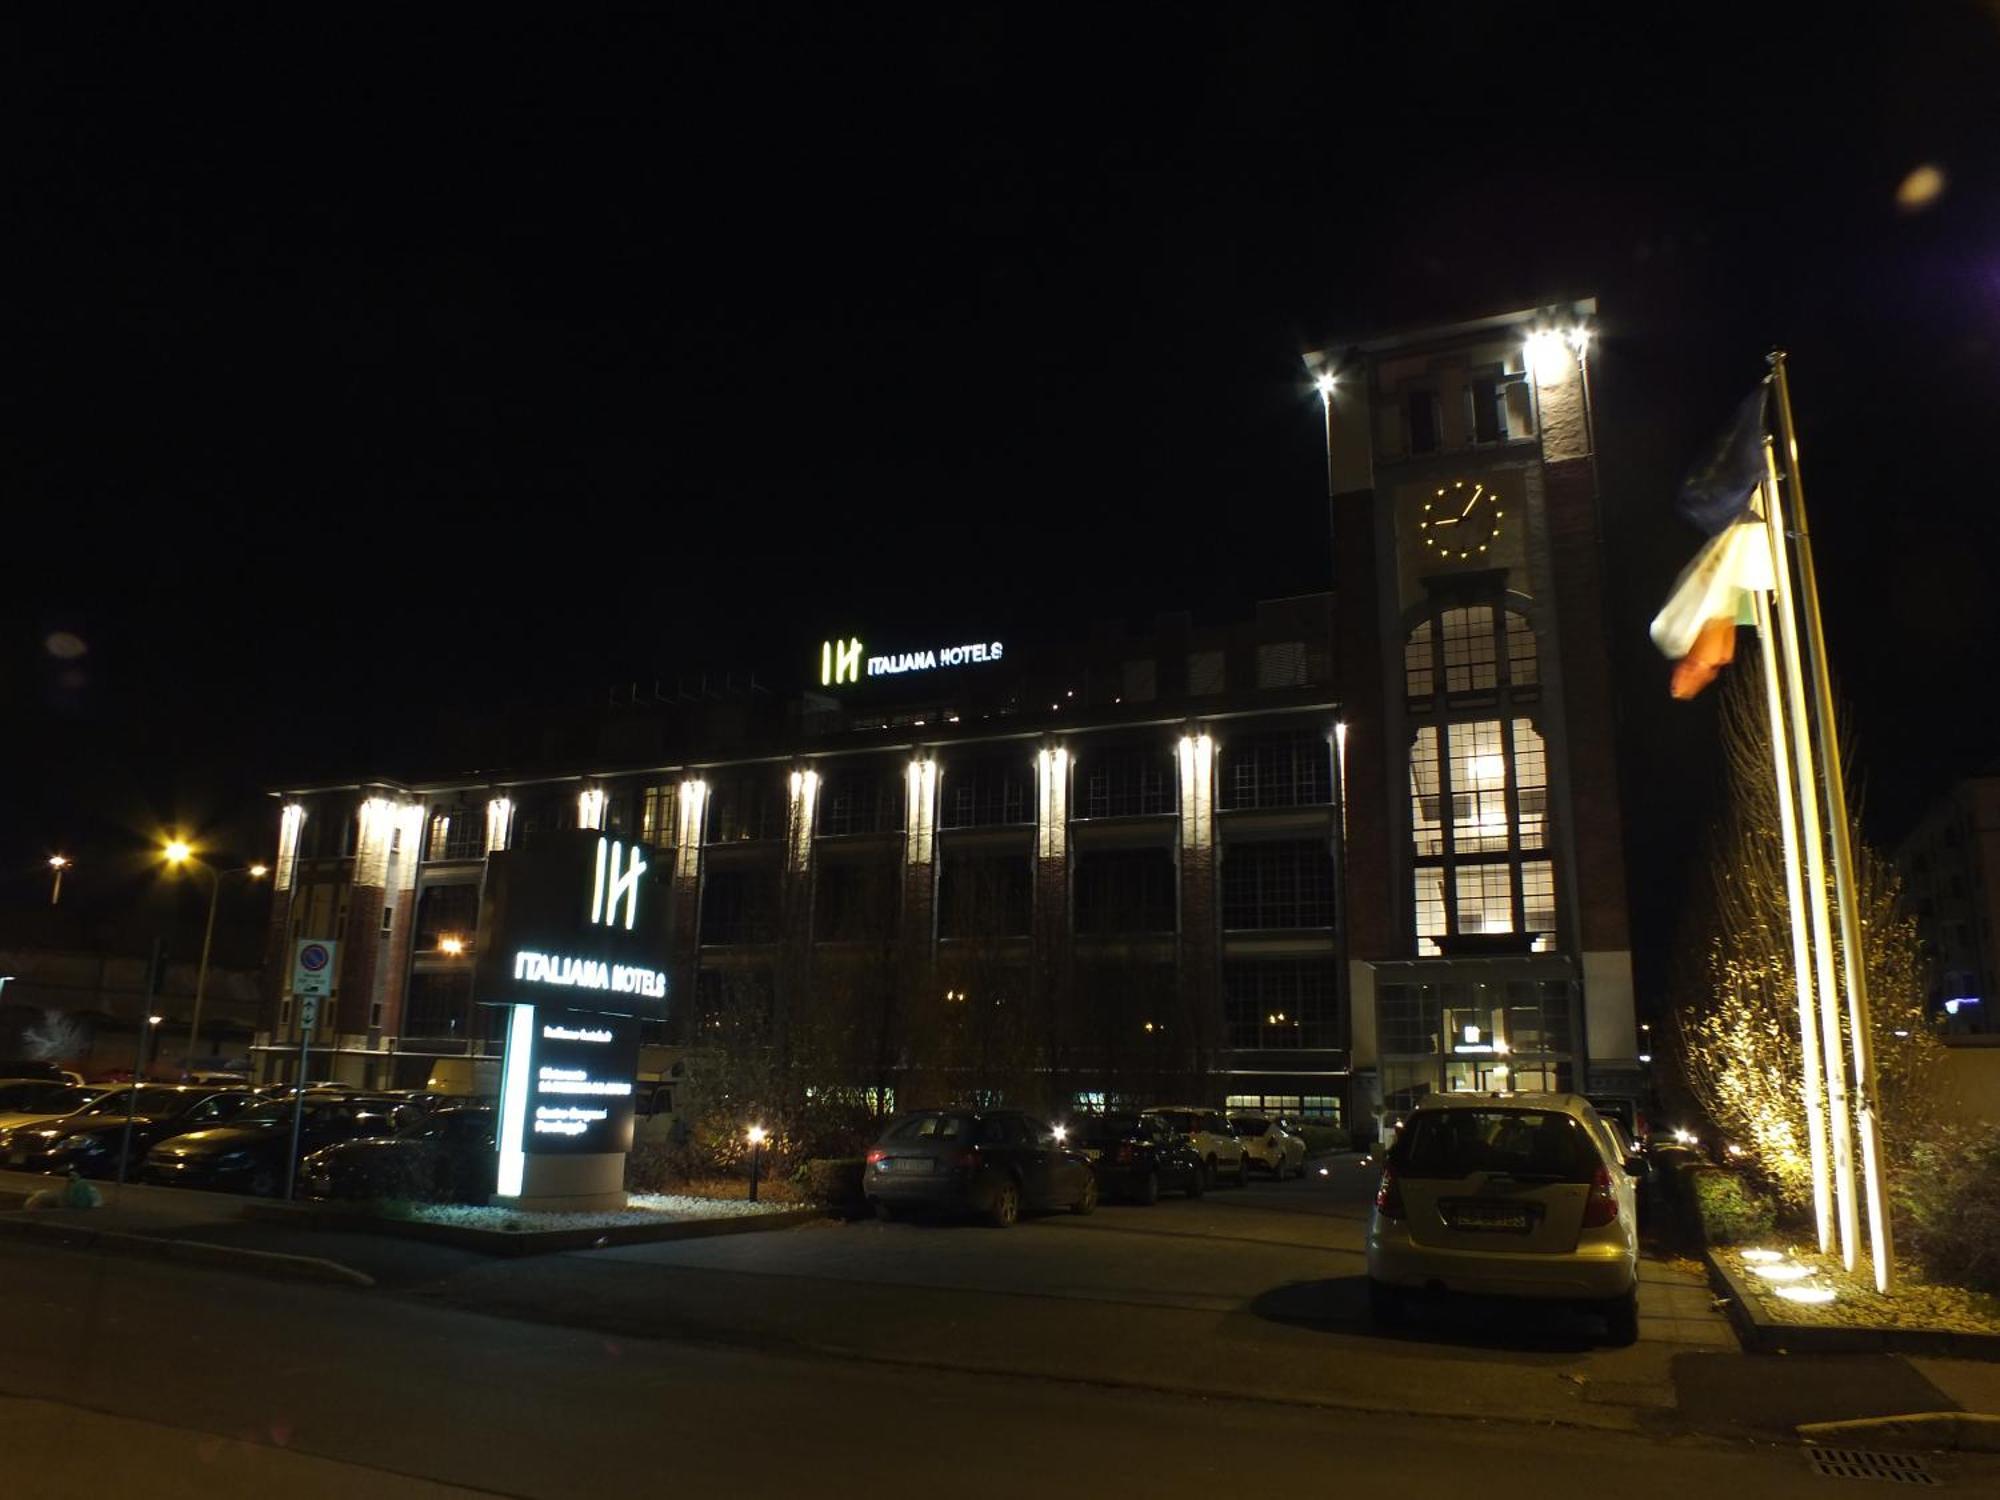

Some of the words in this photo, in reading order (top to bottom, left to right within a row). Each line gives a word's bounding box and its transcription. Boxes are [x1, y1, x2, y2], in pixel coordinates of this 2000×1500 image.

[867, 651, 936, 676] ITALIANA
[940, 642, 1003, 666] HOTELS
[514, 951, 609, 989] ITALIANA
[611, 964, 666, 998] HOTELS
